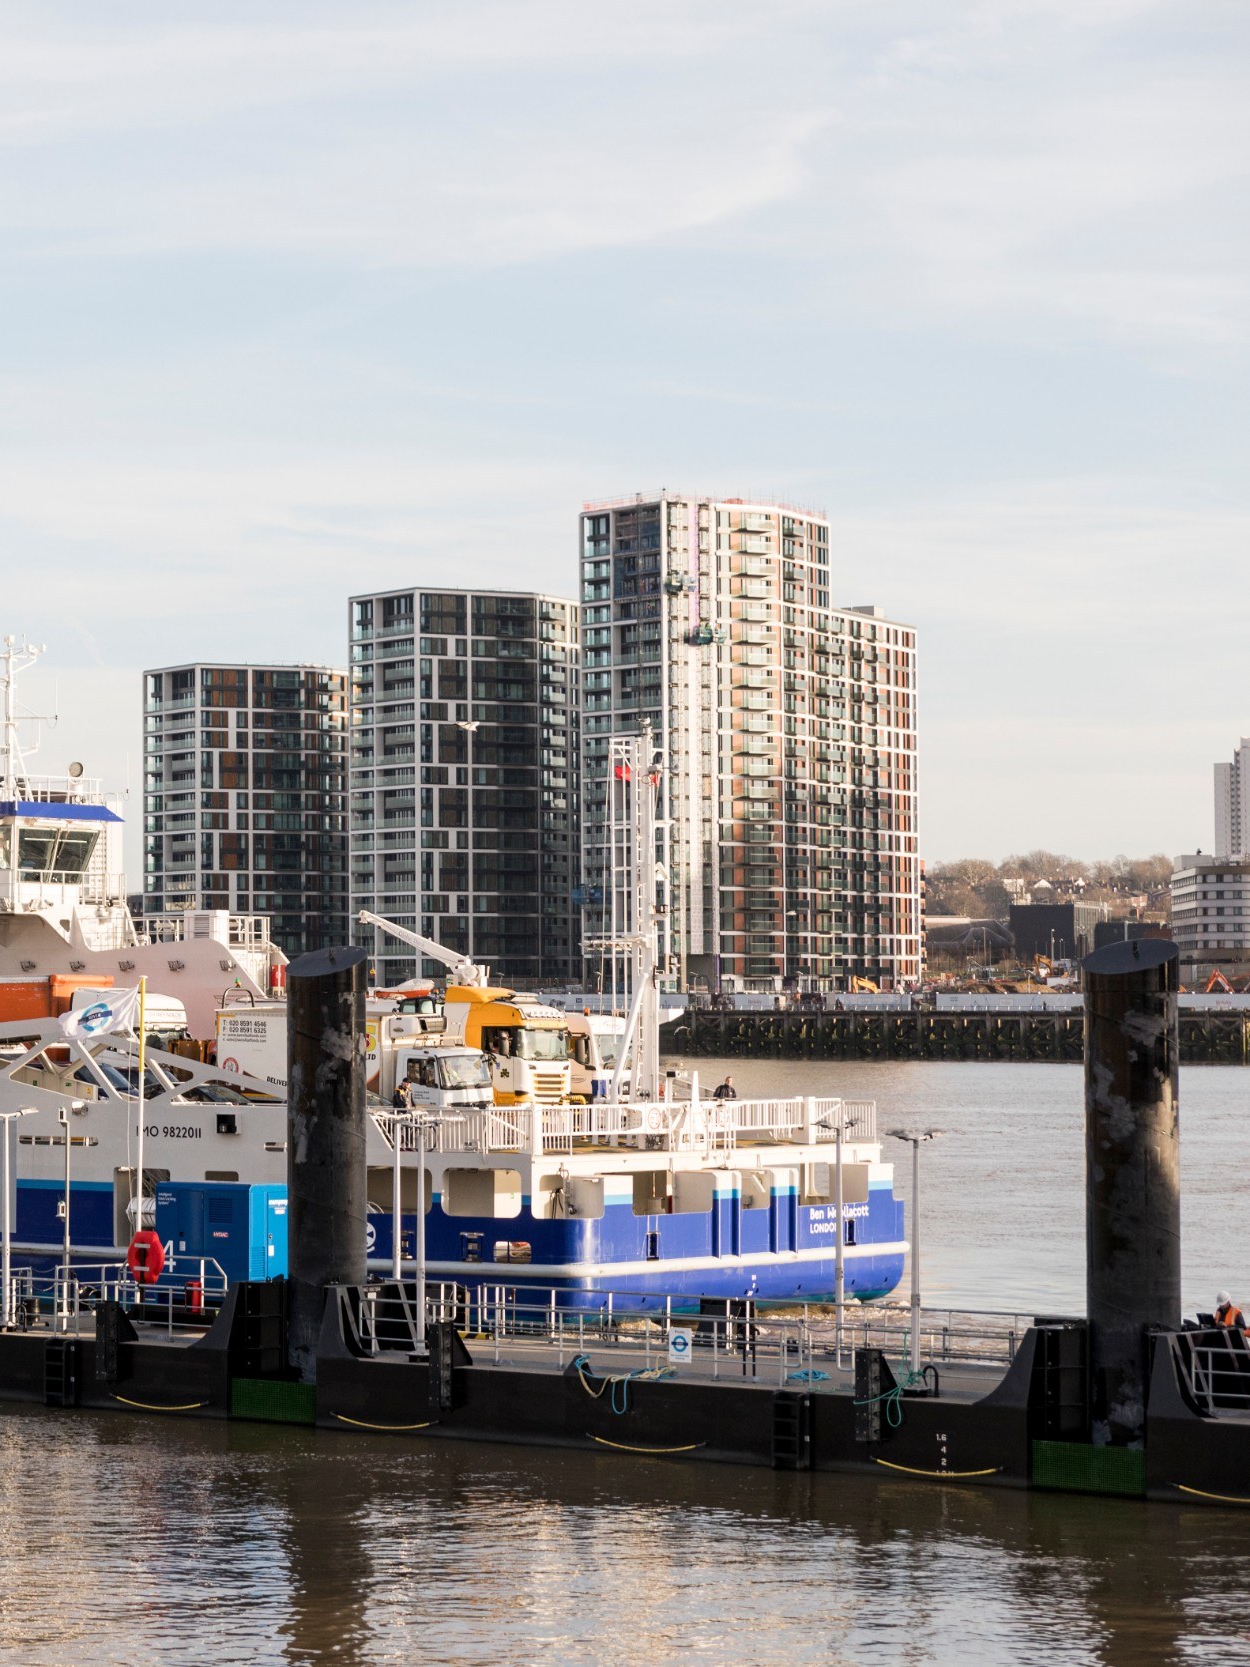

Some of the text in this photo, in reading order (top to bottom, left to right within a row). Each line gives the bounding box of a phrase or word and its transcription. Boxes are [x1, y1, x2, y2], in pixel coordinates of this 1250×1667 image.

[136, 1126, 202, 1138] IMO 9822011
[810, 1205, 869, 1220] Ben Wllacott
[936, 1433, 947, 1441] 1.6
[940, 1446, 947, 1454] 4
[941, 1458, 947, 1466] 2
